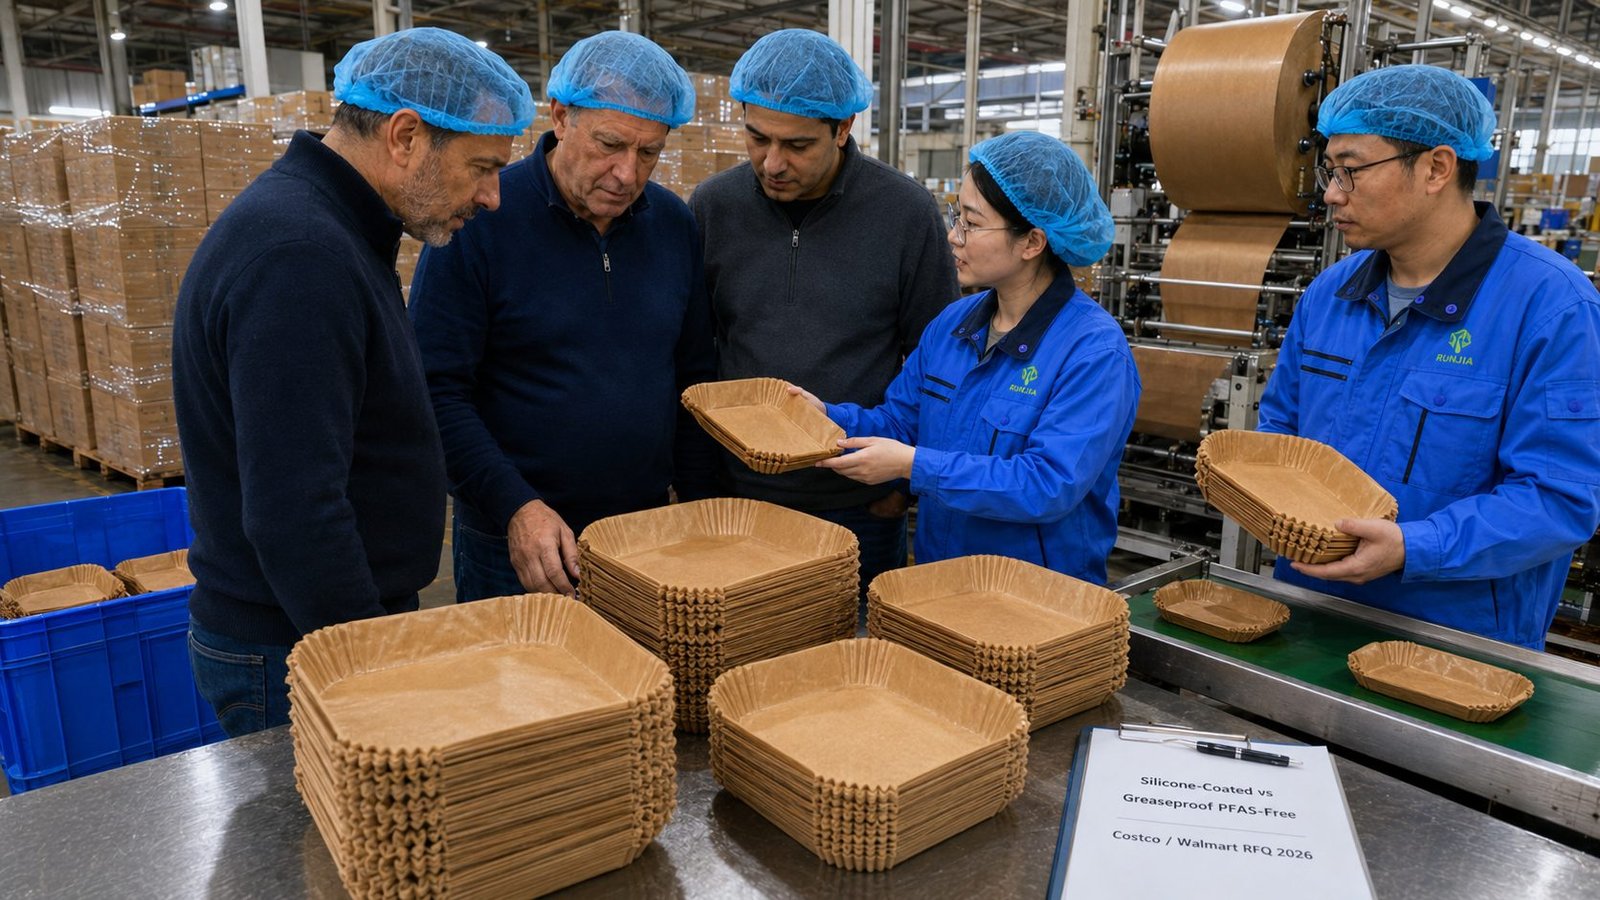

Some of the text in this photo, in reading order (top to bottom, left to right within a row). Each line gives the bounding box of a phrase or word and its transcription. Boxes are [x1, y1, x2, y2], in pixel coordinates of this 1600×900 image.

[1436, 353, 1473, 366] RUNJIA
[1140, 776, 1274, 798] Silicone-Coated vs
[1122, 793, 1297, 820] Greaseproof PFAS-Free
[1112, 830, 1313, 860] Costco / Walmart RFQ 2026
